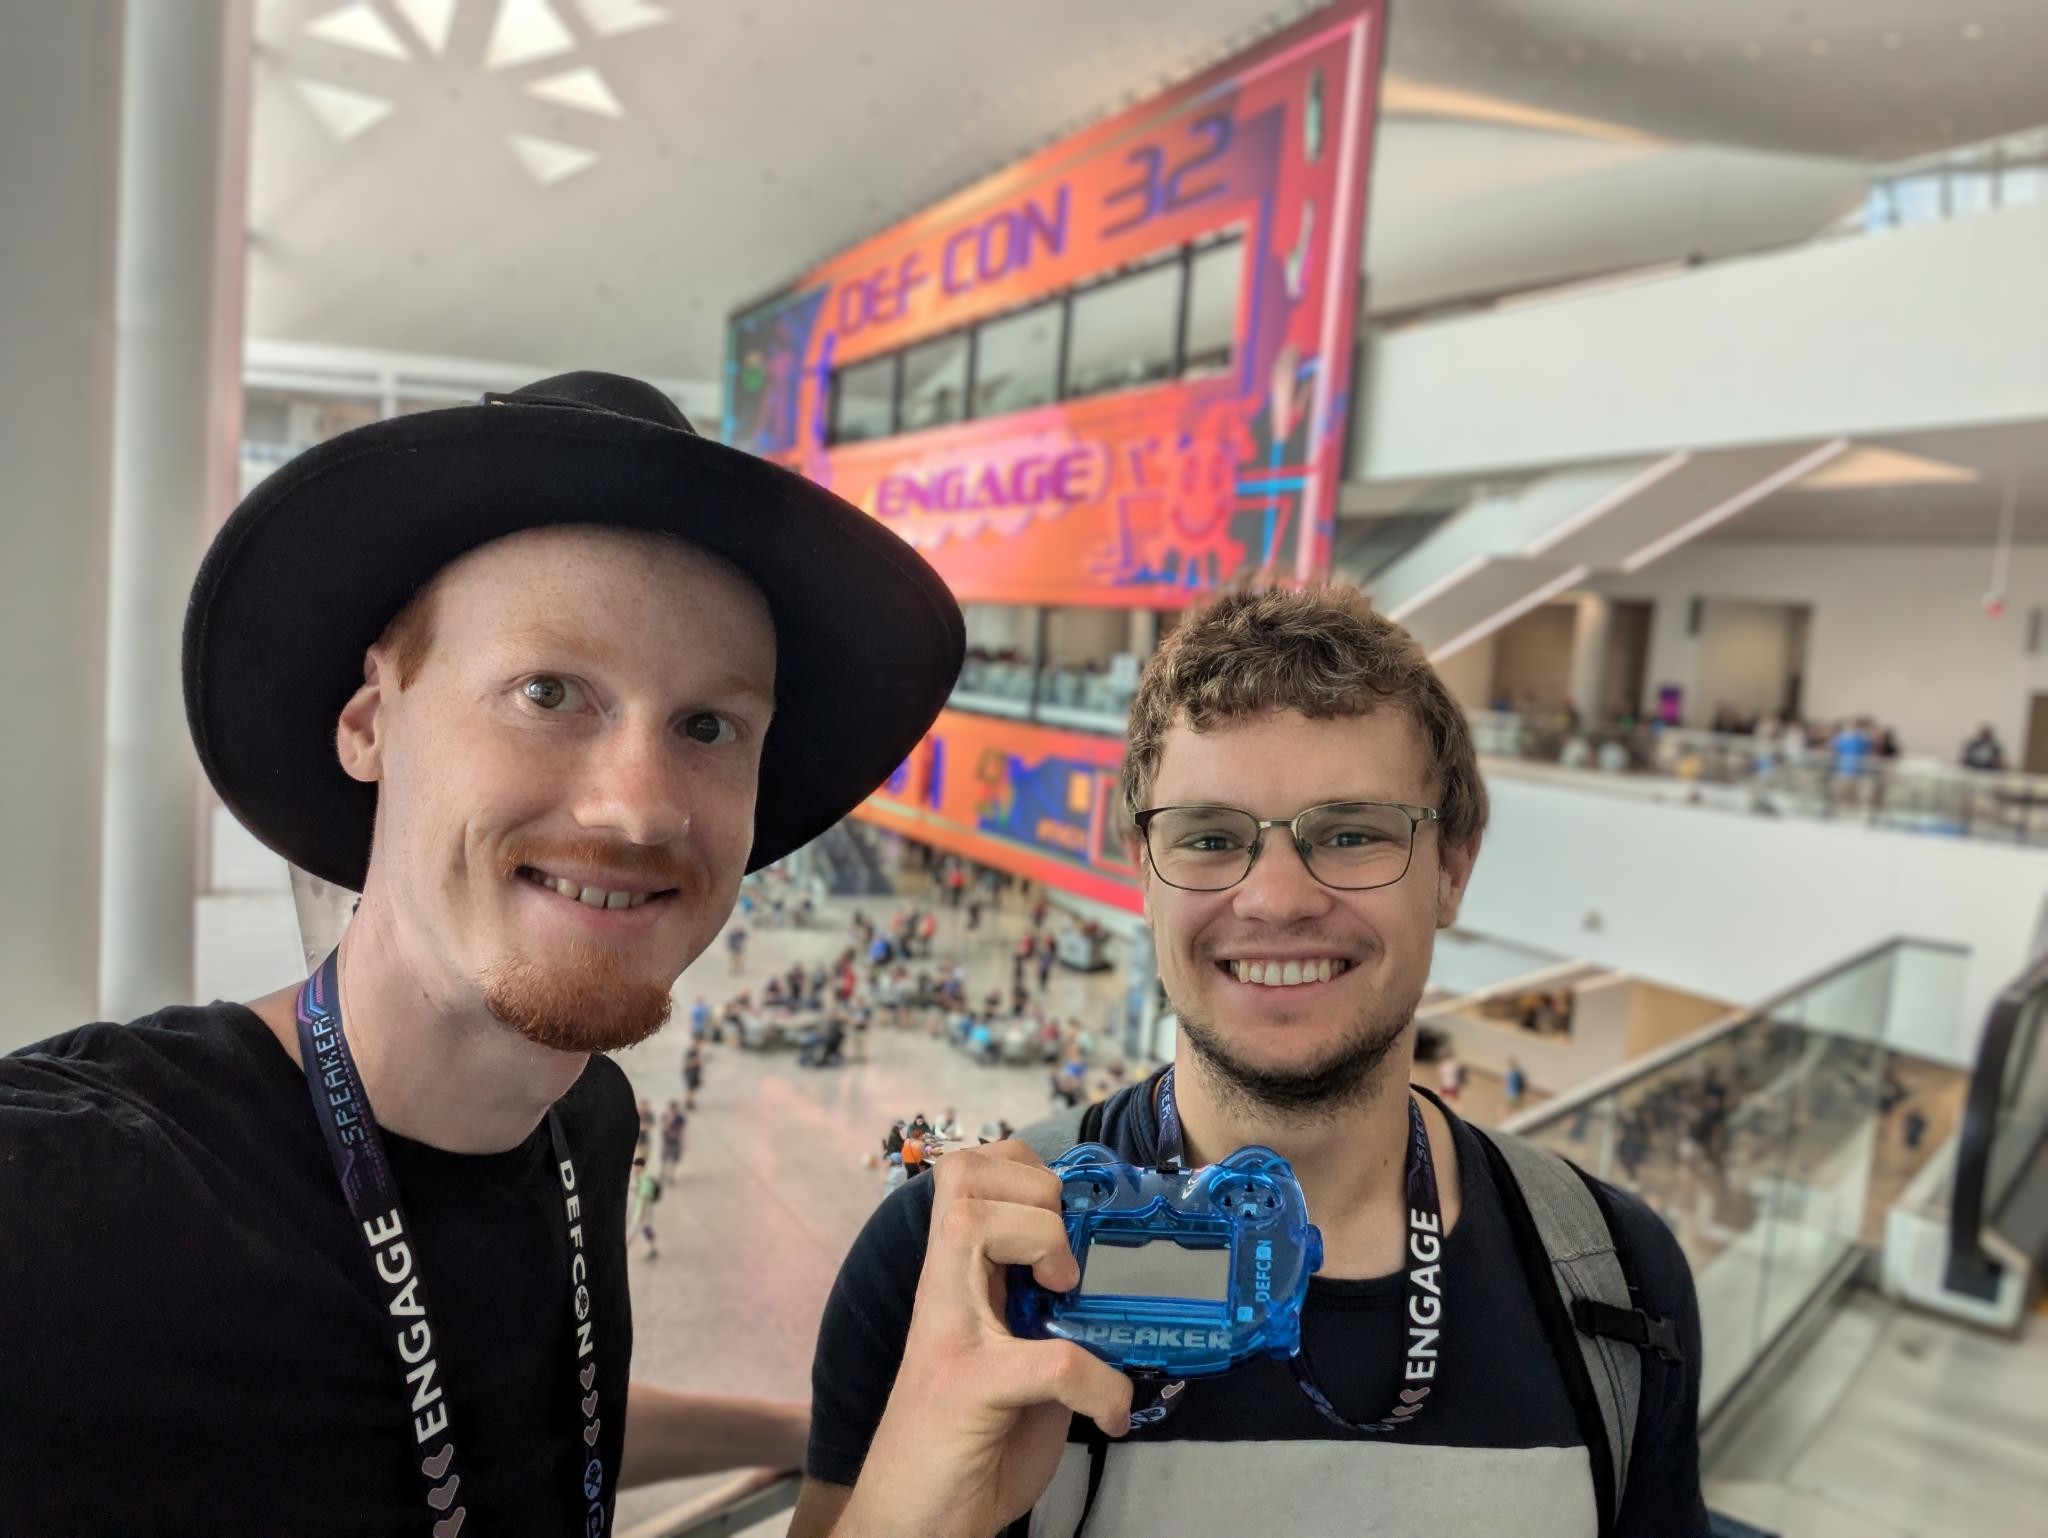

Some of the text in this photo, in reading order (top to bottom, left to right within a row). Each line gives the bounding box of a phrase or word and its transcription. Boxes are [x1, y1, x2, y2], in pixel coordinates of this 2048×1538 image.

[837, 113, 1236, 337] DEF CON 32
[875, 450, 1092, 517] ENGAGE
[312, 1015, 366, 1146] SPEAKER
[363, 1208, 448, 1444] ENGAGE
[560, 1159, 594, 1359] DEFCON
[1405, 1208, 1441, 1380] ENGAGE
